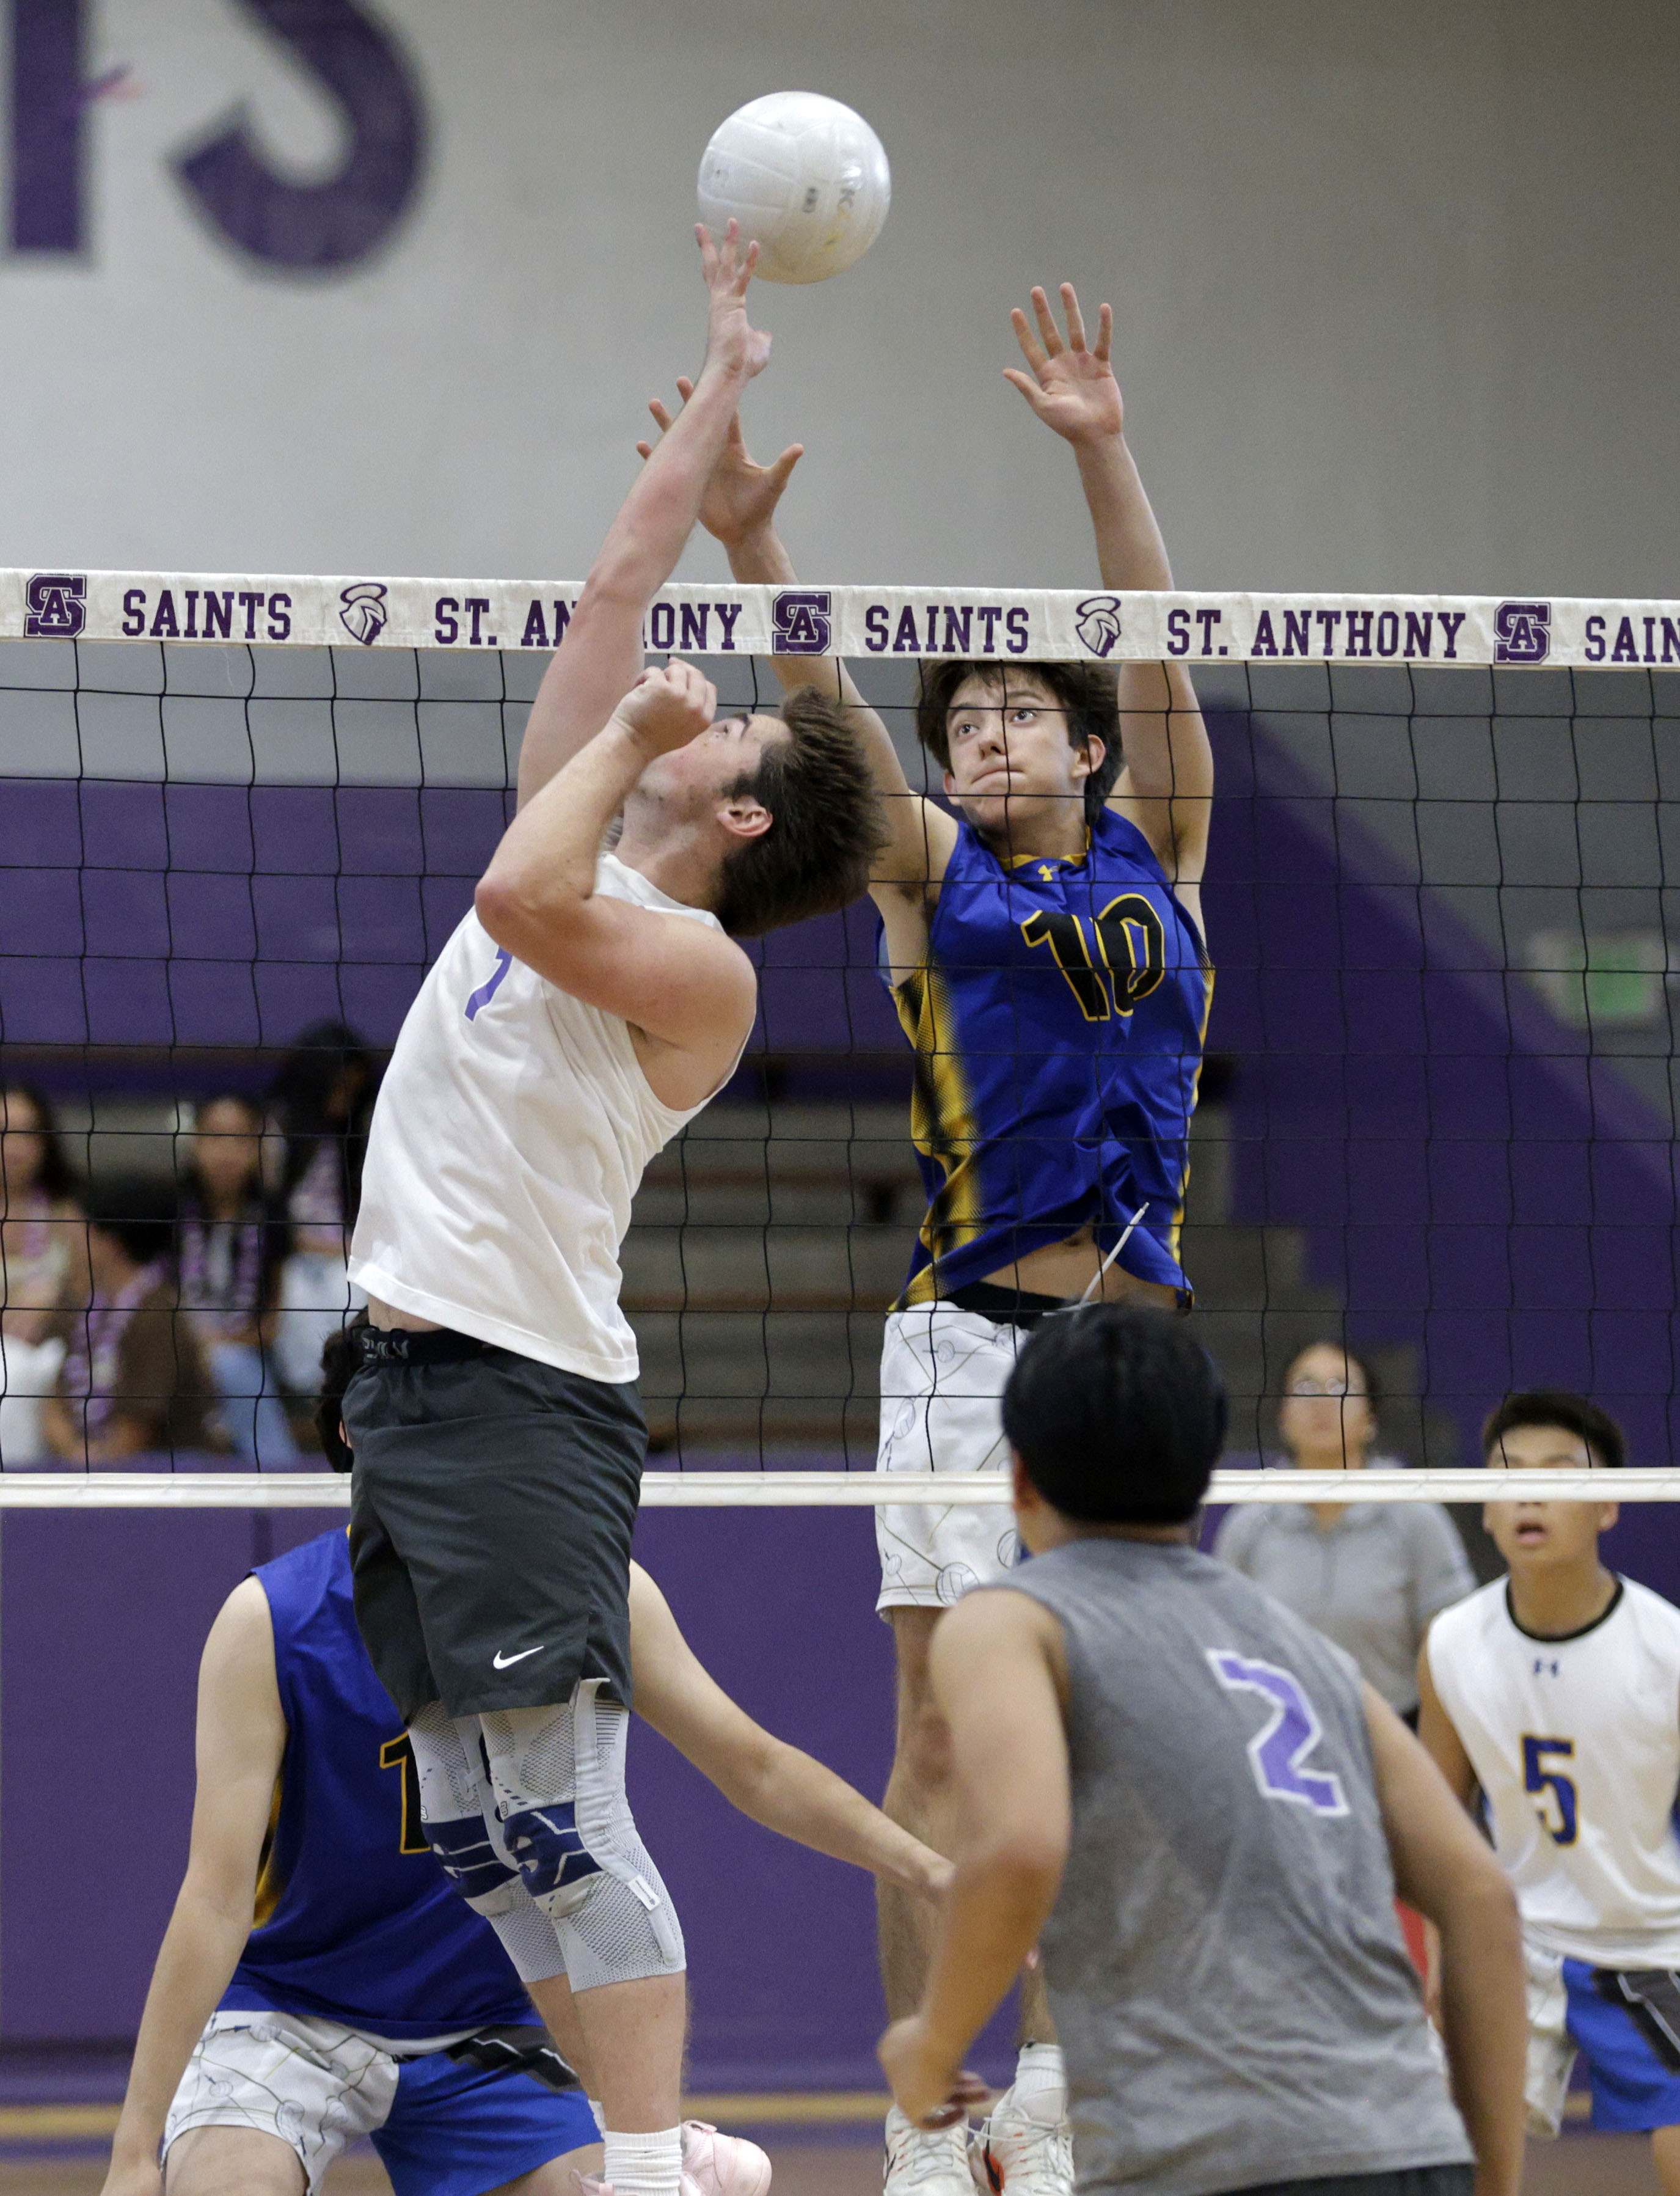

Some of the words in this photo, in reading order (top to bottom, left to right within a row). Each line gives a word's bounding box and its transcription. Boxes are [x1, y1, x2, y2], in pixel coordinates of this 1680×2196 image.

[122, 589, 291, 640] SAINTS
[434, 597, 497, 646] ST.
[521, 599, 742, 650] ANONY
[865, 605, 1029, 654] SAINTS
[1167, 609, 1228, 656] ST.
[1251, 610, 1466, 658] ANTHONY
[1021, 893, 1165, 1021] 10
[1205, 1649, 1351, 1816] 2
[1520, 1731, 1579, 1847] 5
